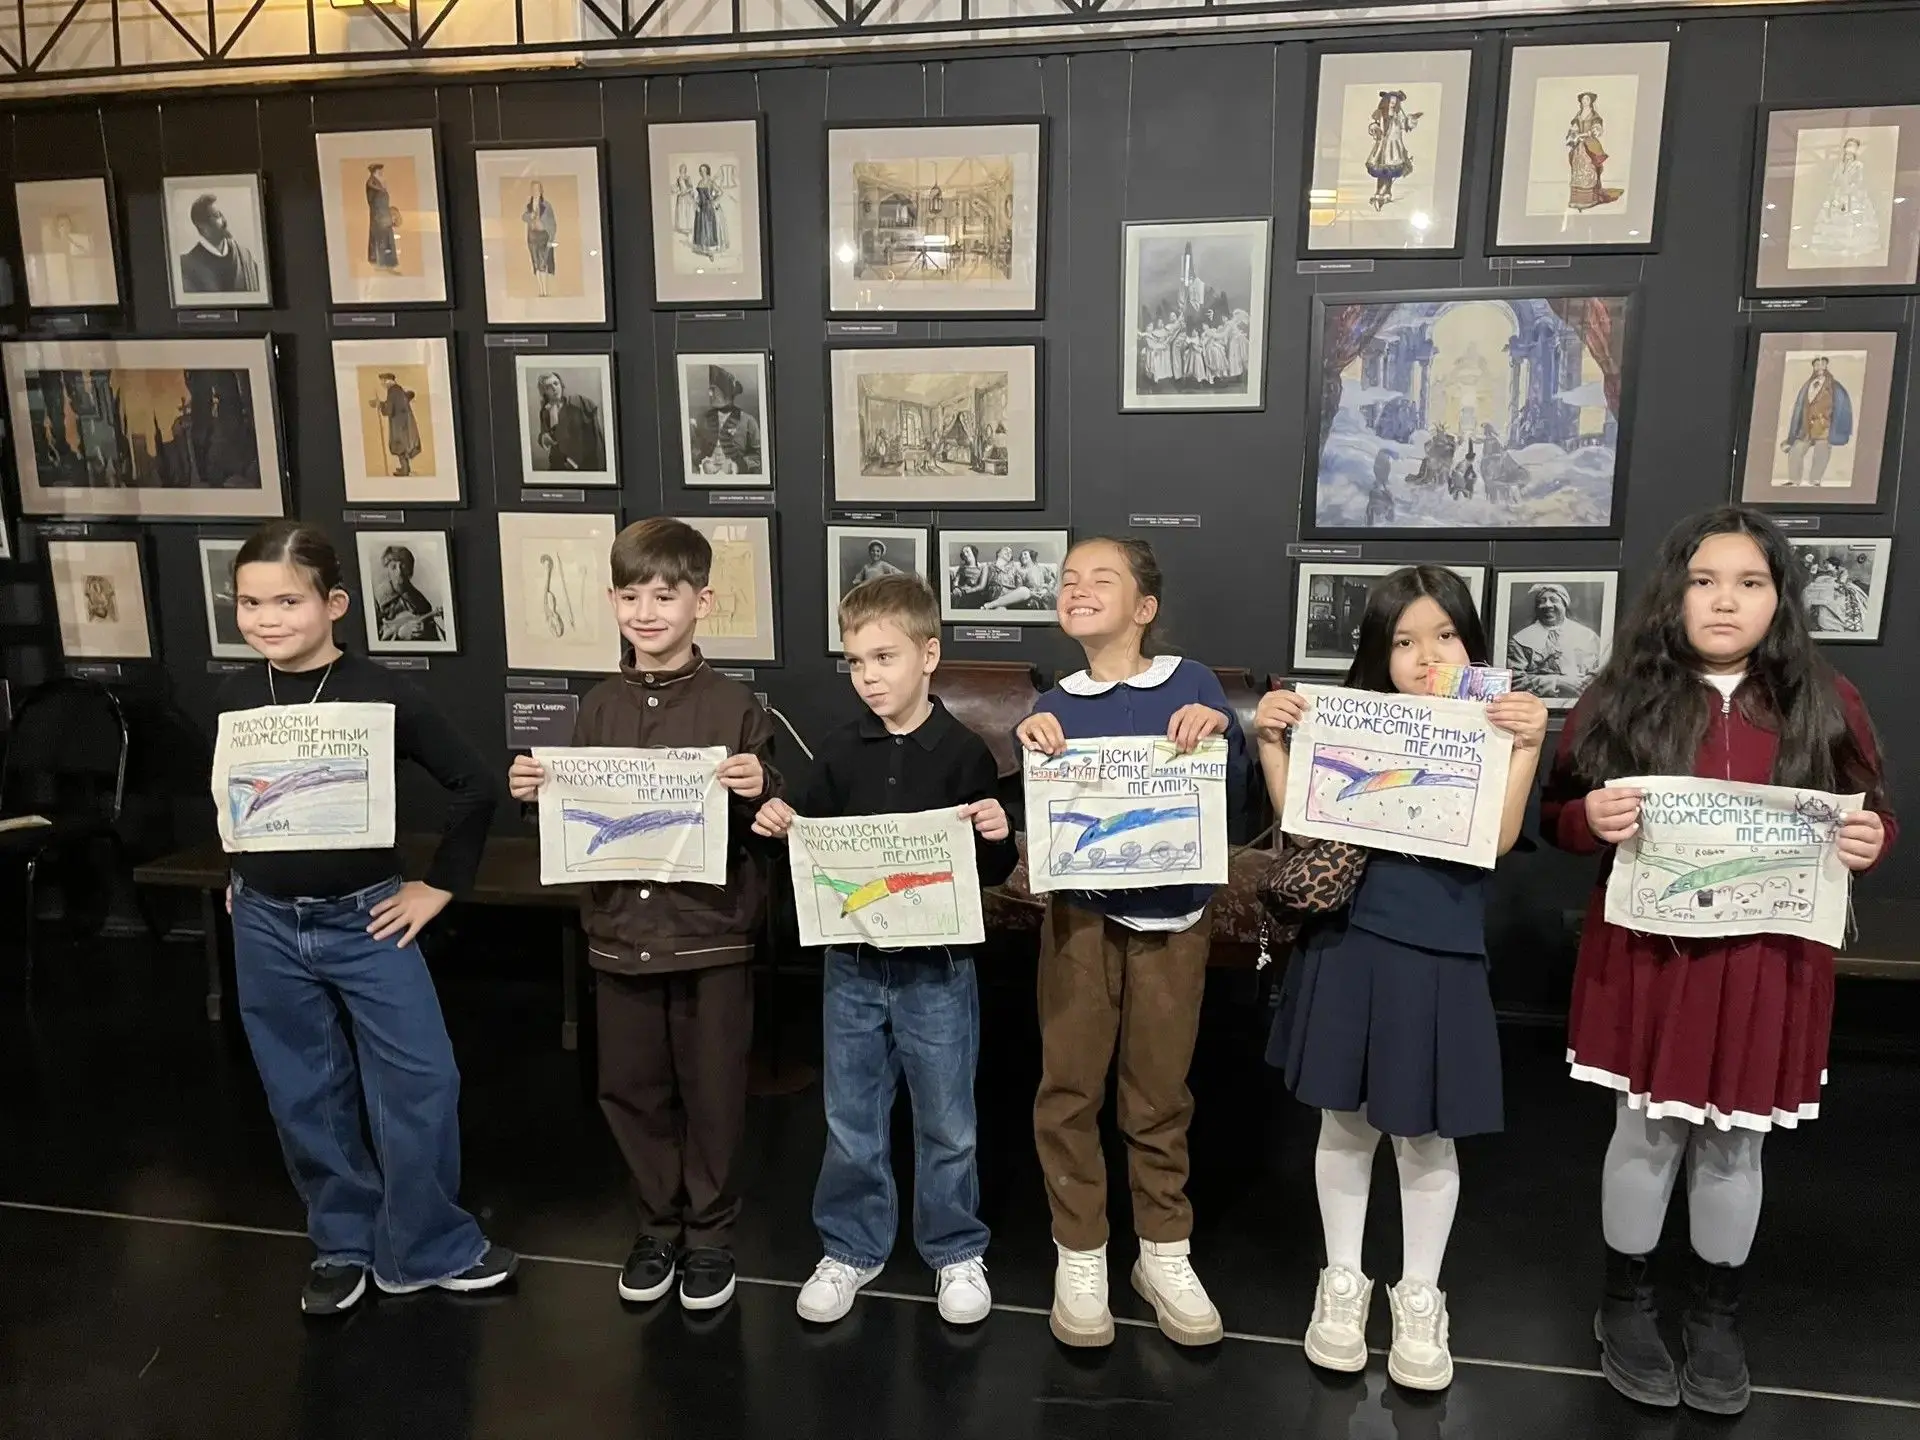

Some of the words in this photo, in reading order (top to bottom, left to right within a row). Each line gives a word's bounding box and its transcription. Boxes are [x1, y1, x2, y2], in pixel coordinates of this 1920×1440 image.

[1315, 711, 1486, 744] ХУДОЖЕСТВЕННЫЙ
[1190, 762, 1226, 777] МХАТ
[265, 819, 290, 832] ЕВА
